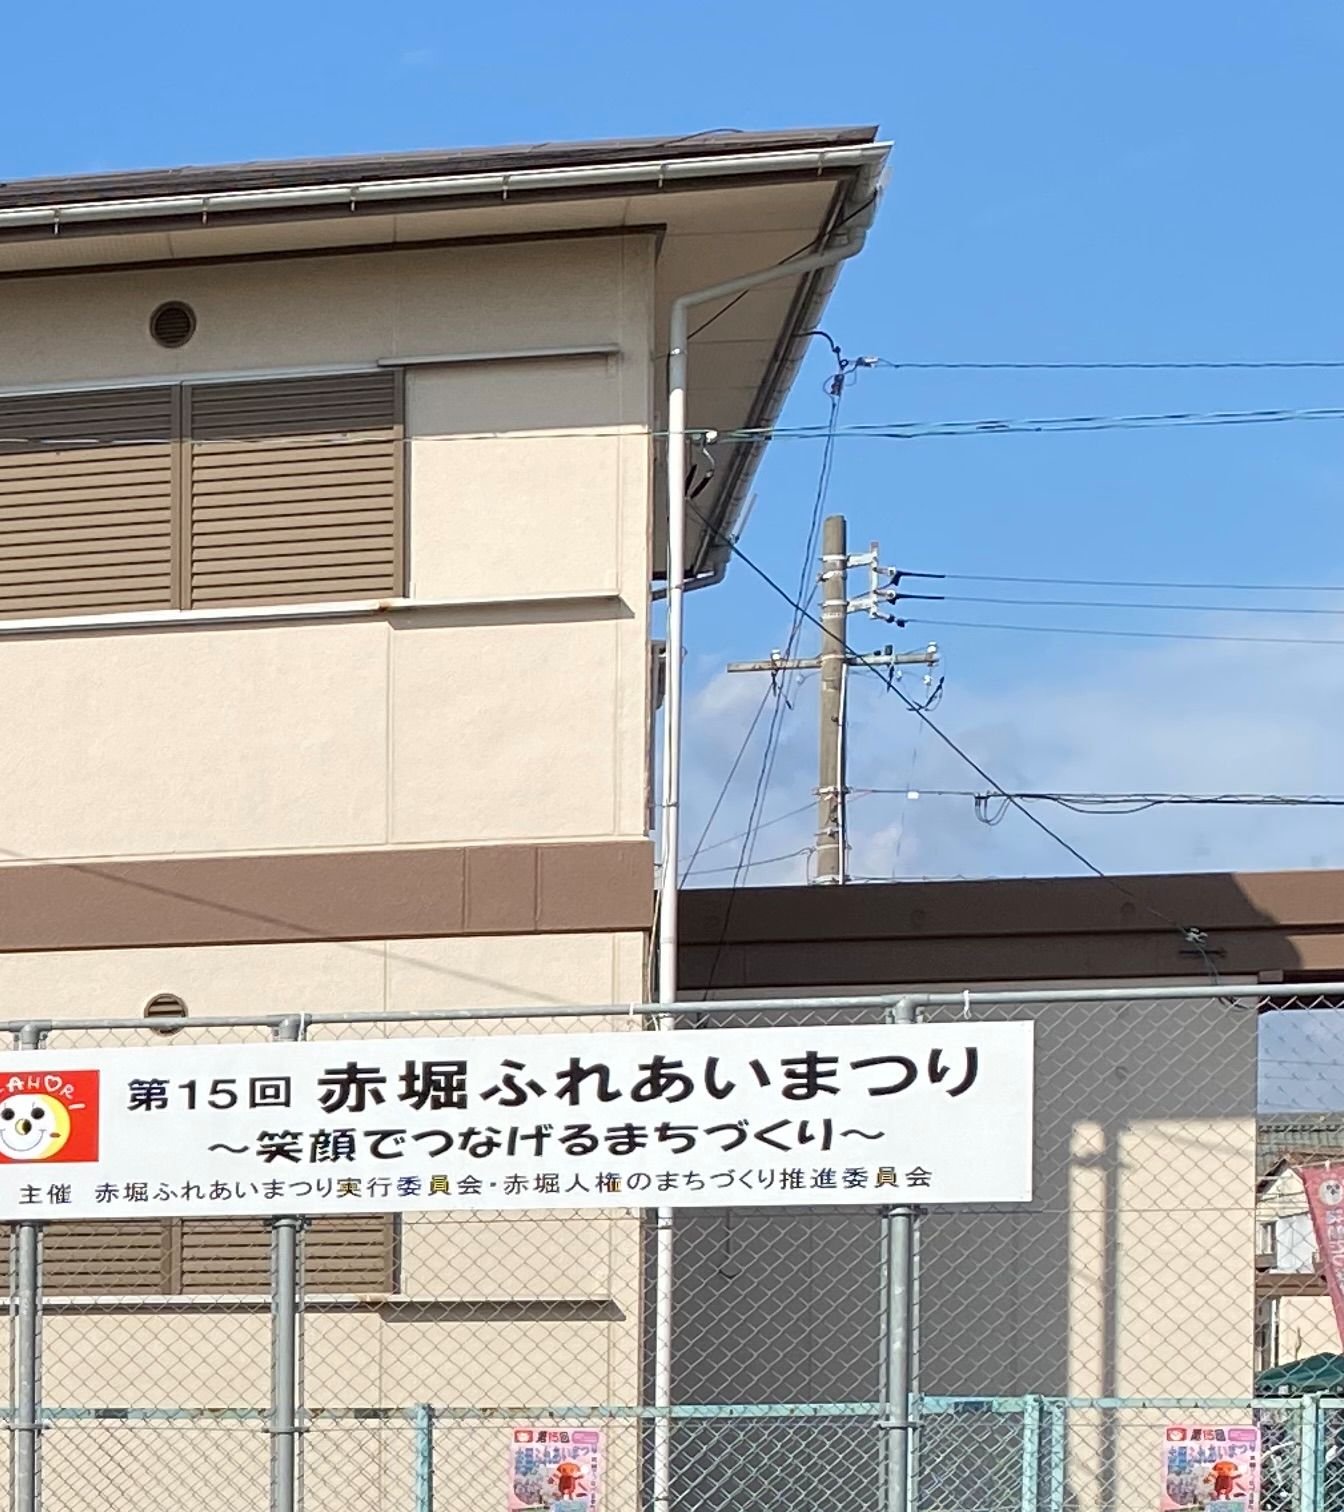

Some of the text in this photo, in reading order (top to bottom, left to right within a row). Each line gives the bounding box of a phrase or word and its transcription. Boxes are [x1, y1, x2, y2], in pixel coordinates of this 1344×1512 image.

[126, 1045, 980, 1114] 第15回 赤堀ふれあいまつり
[18, 1166, 933, 1205] 主催 赤堀ふれあいまつり実行委員会・赤堀人権のまちづくり推進委員会
